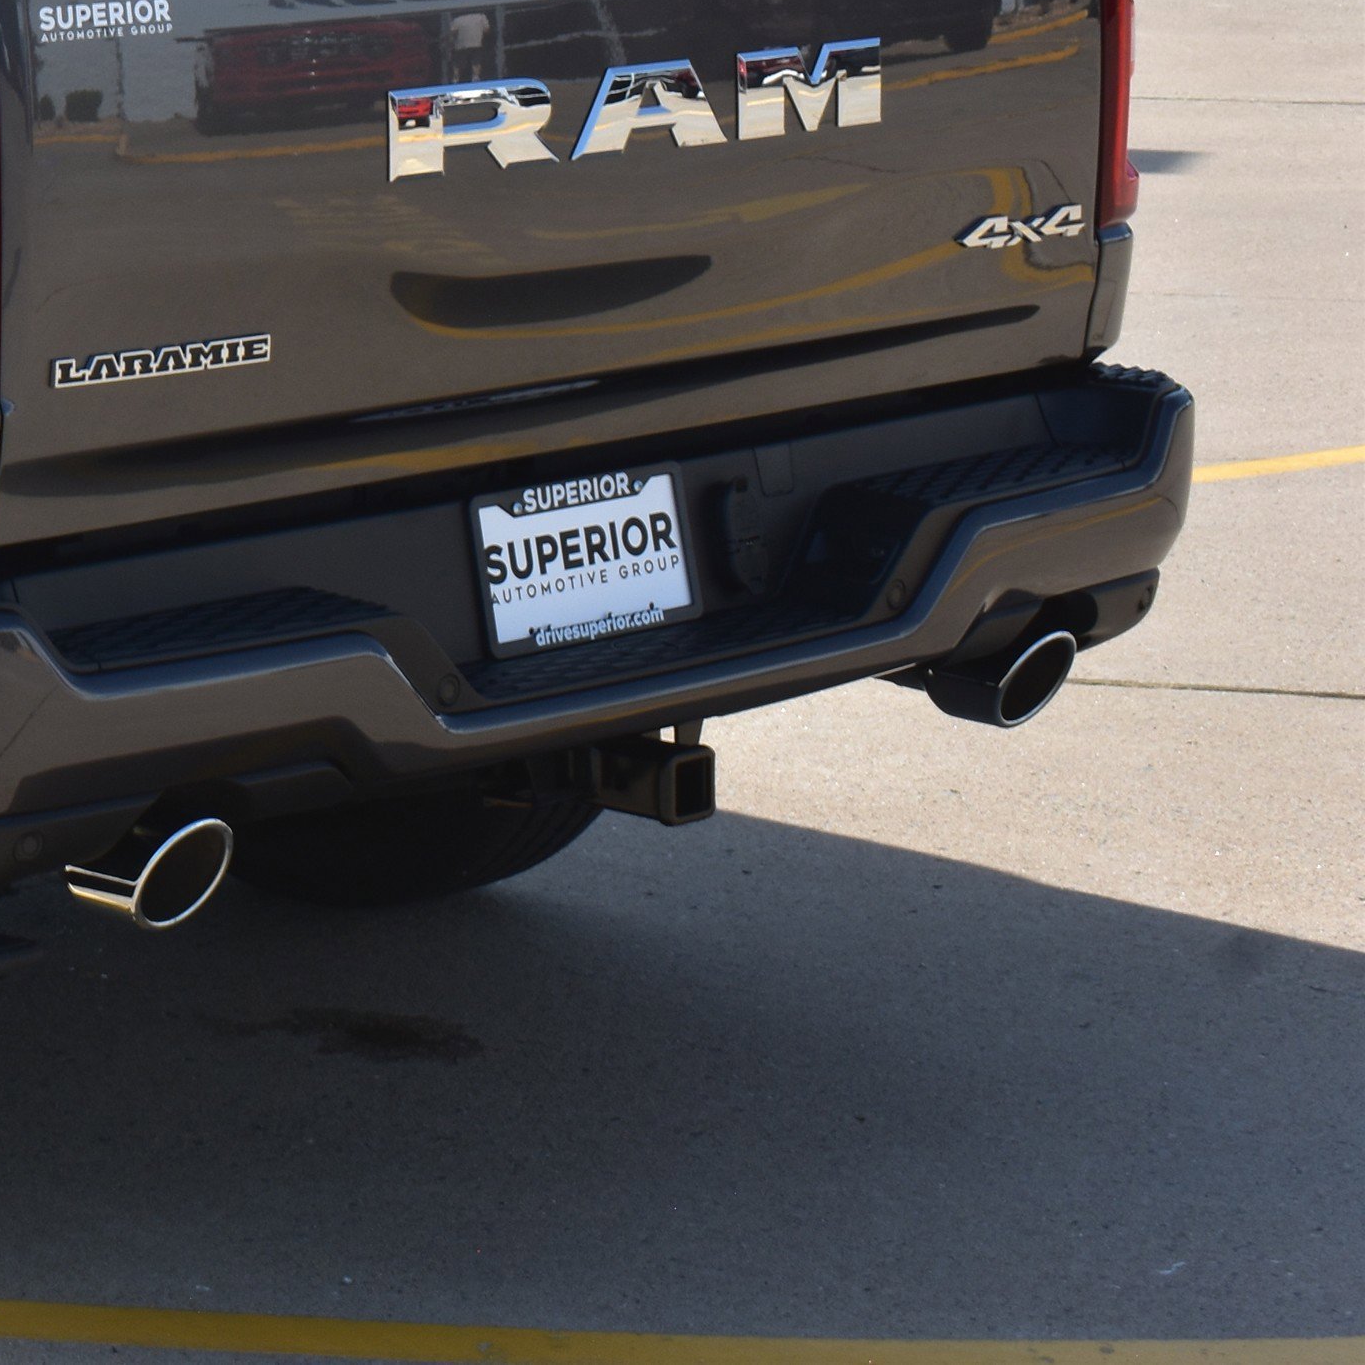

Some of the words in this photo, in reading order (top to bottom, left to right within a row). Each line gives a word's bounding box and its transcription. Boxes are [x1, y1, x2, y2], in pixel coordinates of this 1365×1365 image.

[40, 27, 124, 43] AUTOMOTIVE
[130, 23, 173, 36] GROUP
[387, 37, 881, 182] RAM
[957, 203, 1086, 249] 4x4
[53, 333, 271, 388] LARAMIE
[522, 471, 631, 513] SUPERIOR
[484, 511, 677, 585] SUPERIOR
[490, 568, 608, 605] AUTOMOTIVE
[618, 555, 680, 579] GROUP
[535, 607, 665, 647] drivesuperior.com
